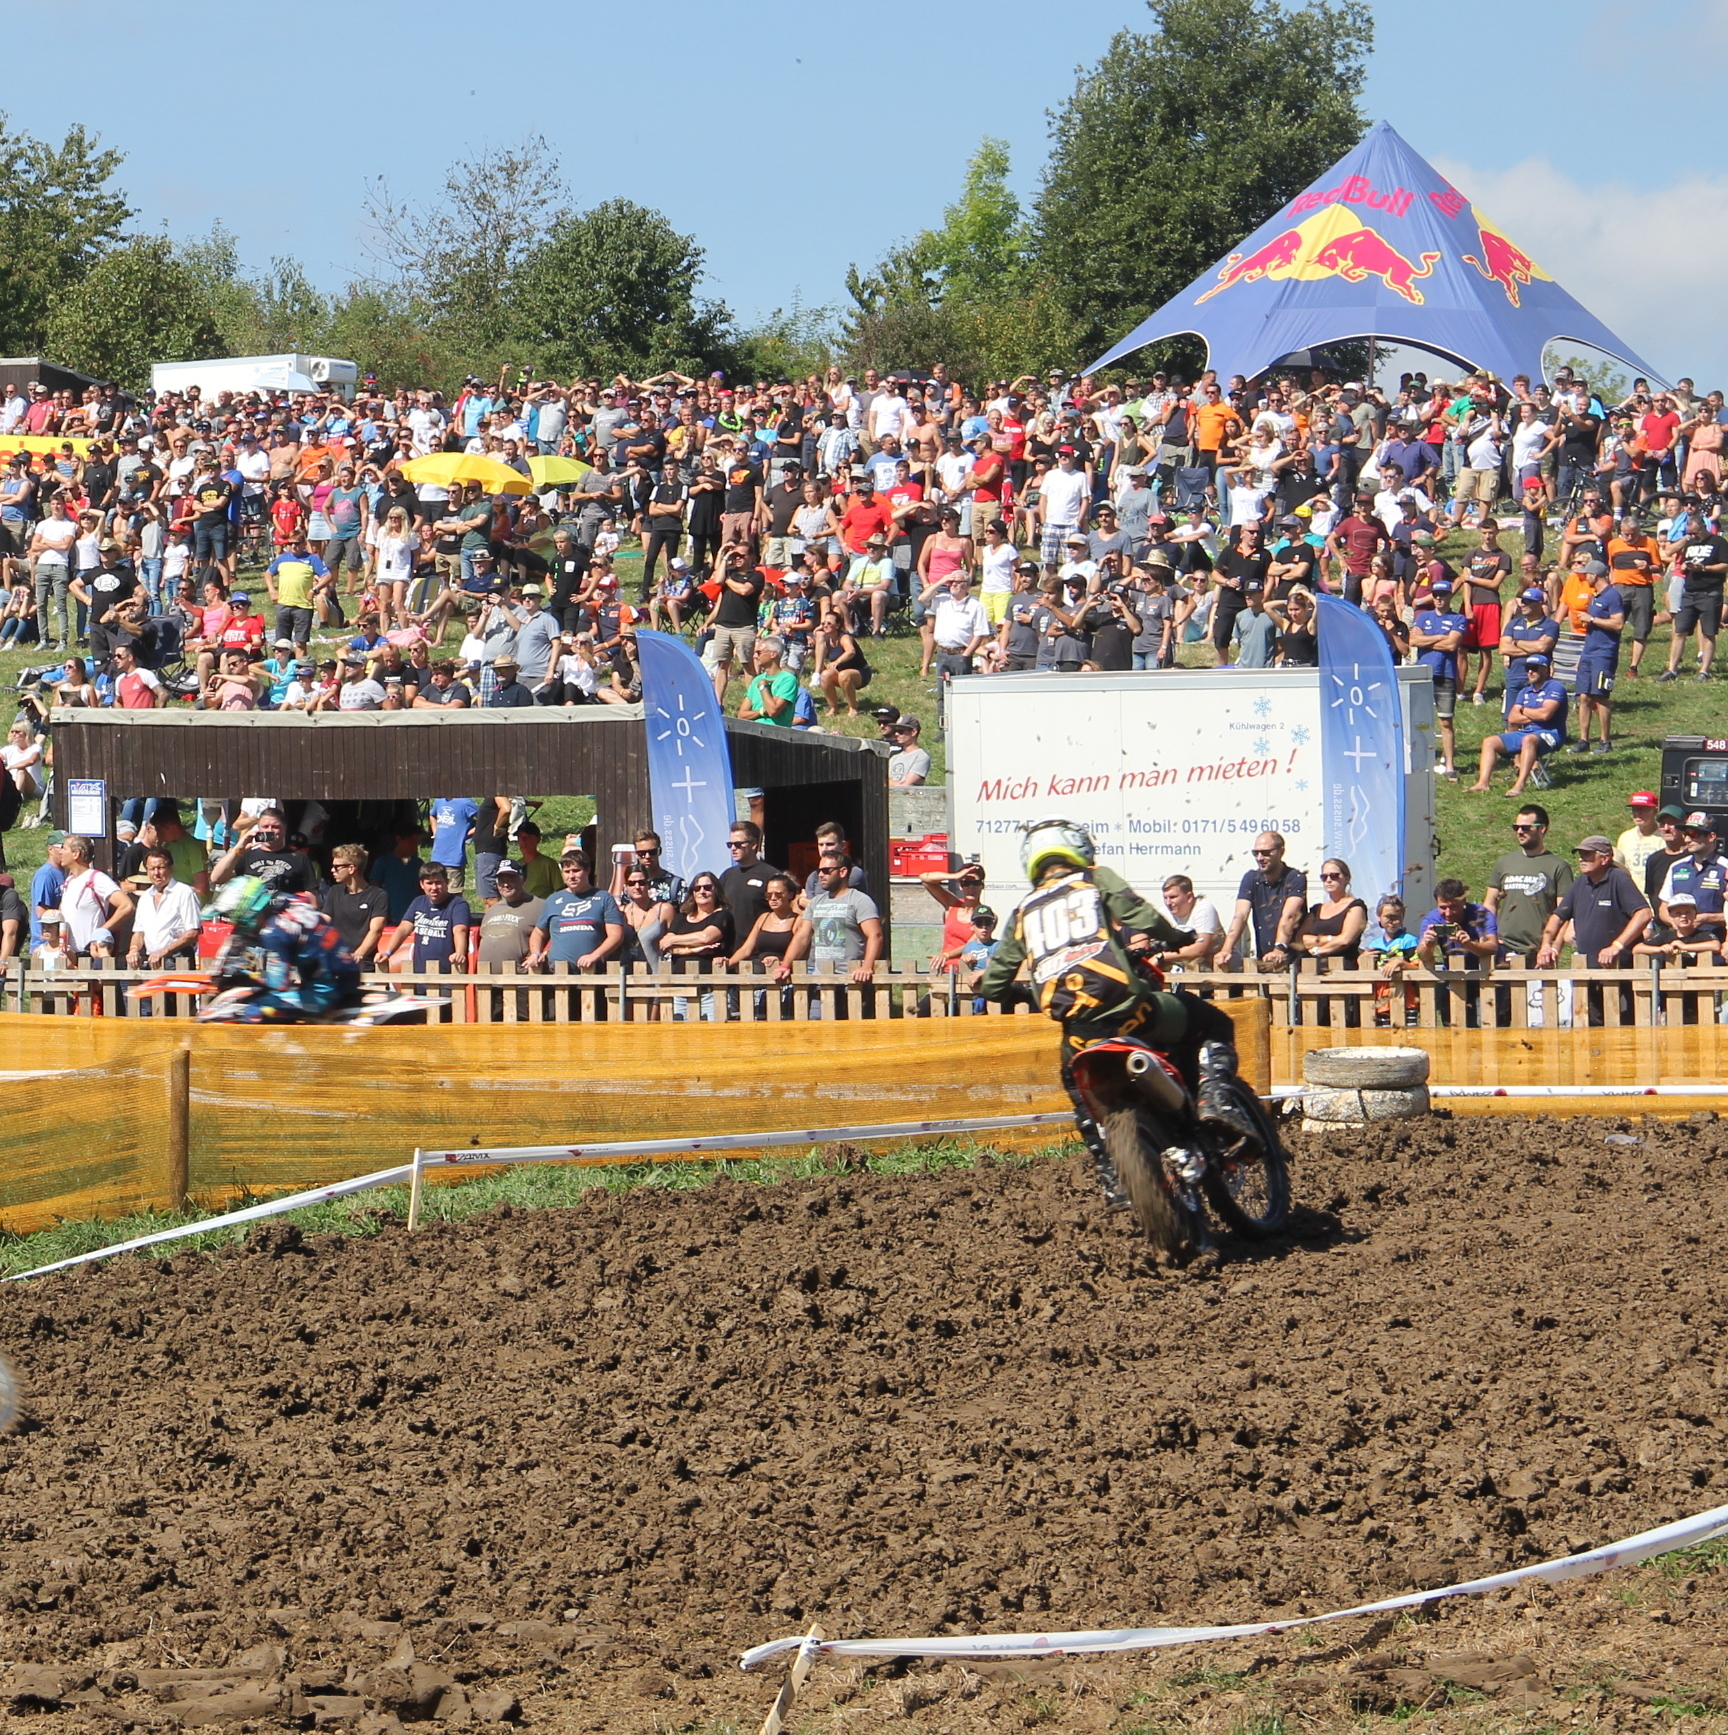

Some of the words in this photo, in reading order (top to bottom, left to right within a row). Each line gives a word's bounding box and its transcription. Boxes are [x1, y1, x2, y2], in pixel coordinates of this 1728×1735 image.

[1229, 722, 1277, 732] Kühlwagen
[1707, 741, 1726, 750] 548
[976, 776, 1038, 803] Mich
[1047, 773, 1110, 797] kann
[1119, 765, 1178, 789] man
[1187, 757, 1277, 783] mieten
[976, 820, 1021, 834] 71277
[1129, 819, 1176, 833] Mobil:
[1182, 819, 1236, 833] 0171/5
[1283, 819, 1300, 833] 58
[1129, 843, 1202, 855] Herrmann
[1023, 886, 1100, 959] 403
[559, 925, 595, 933] HONDA
